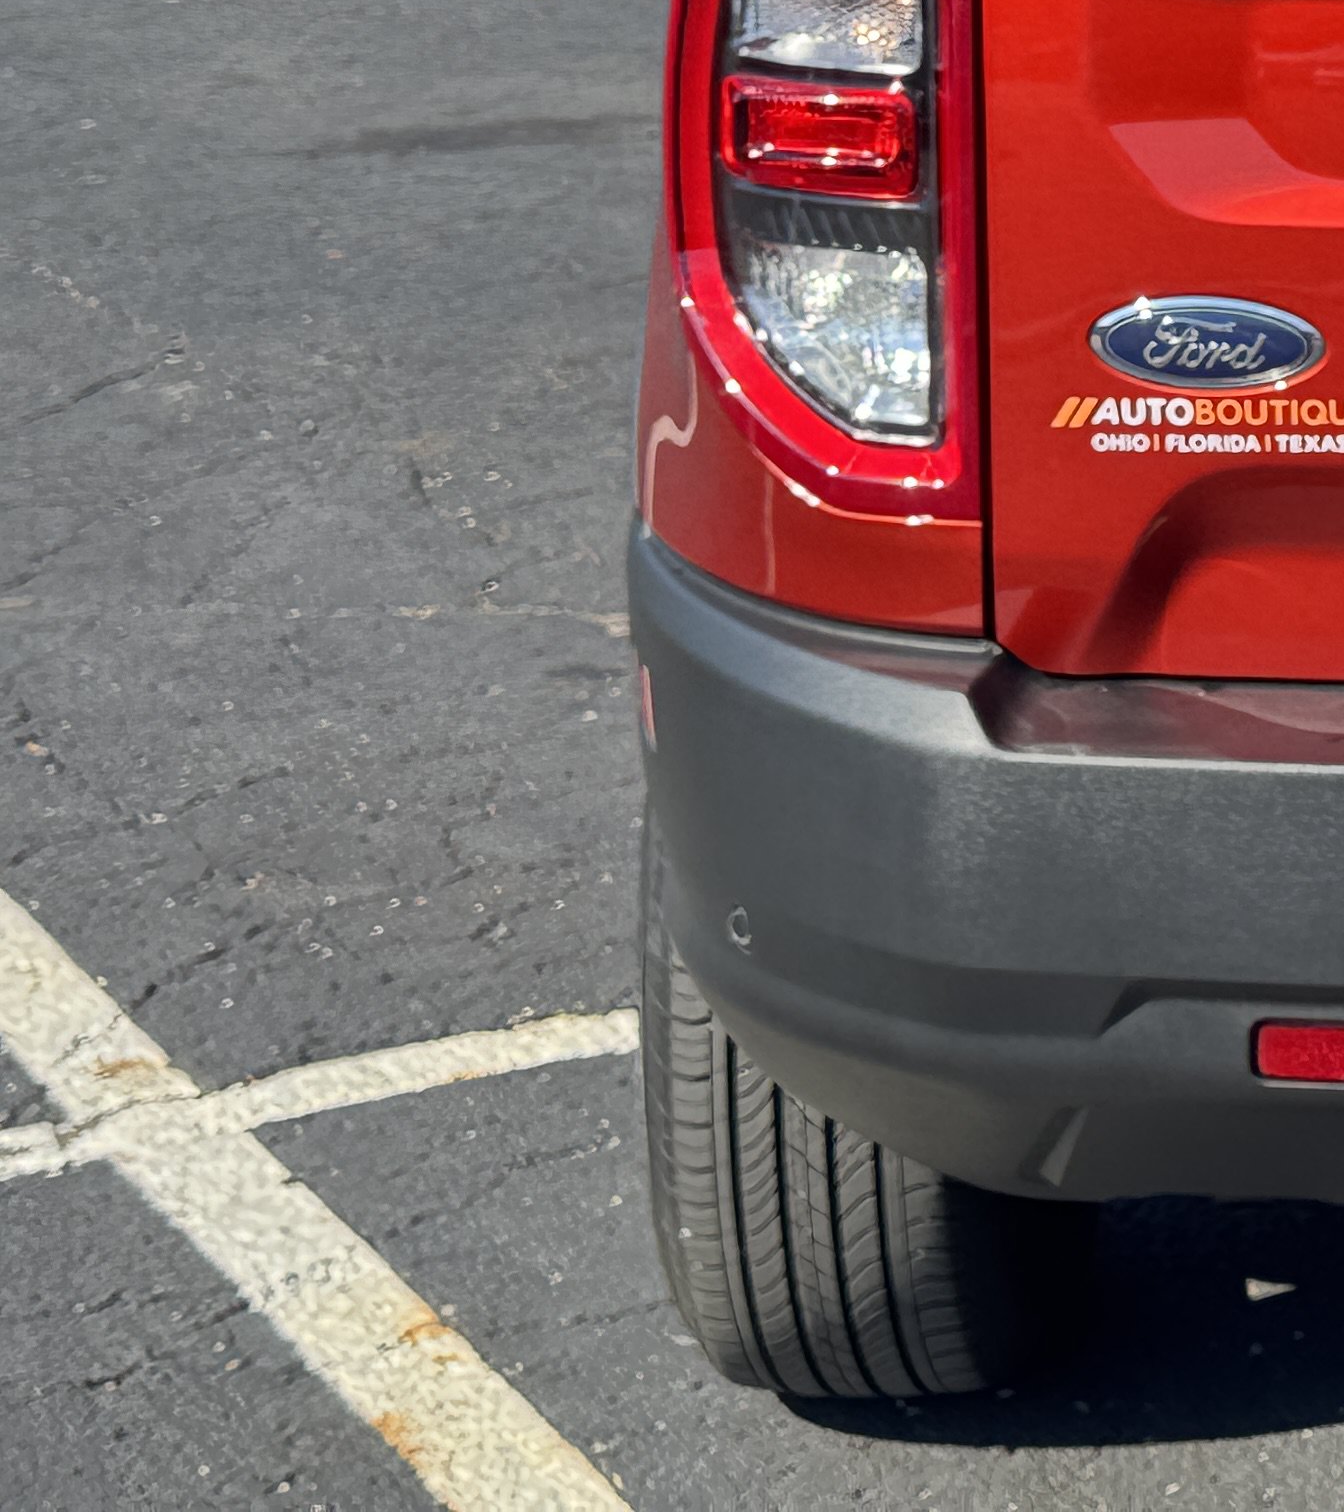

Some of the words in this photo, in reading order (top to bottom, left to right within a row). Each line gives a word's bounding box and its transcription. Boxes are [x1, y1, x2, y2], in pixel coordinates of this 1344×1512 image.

[1142, 314, 1267, 370] Ford
[1090, 433, 1151, 454] OHIO
[1165, 433, 1262, 454] FLORIDA
